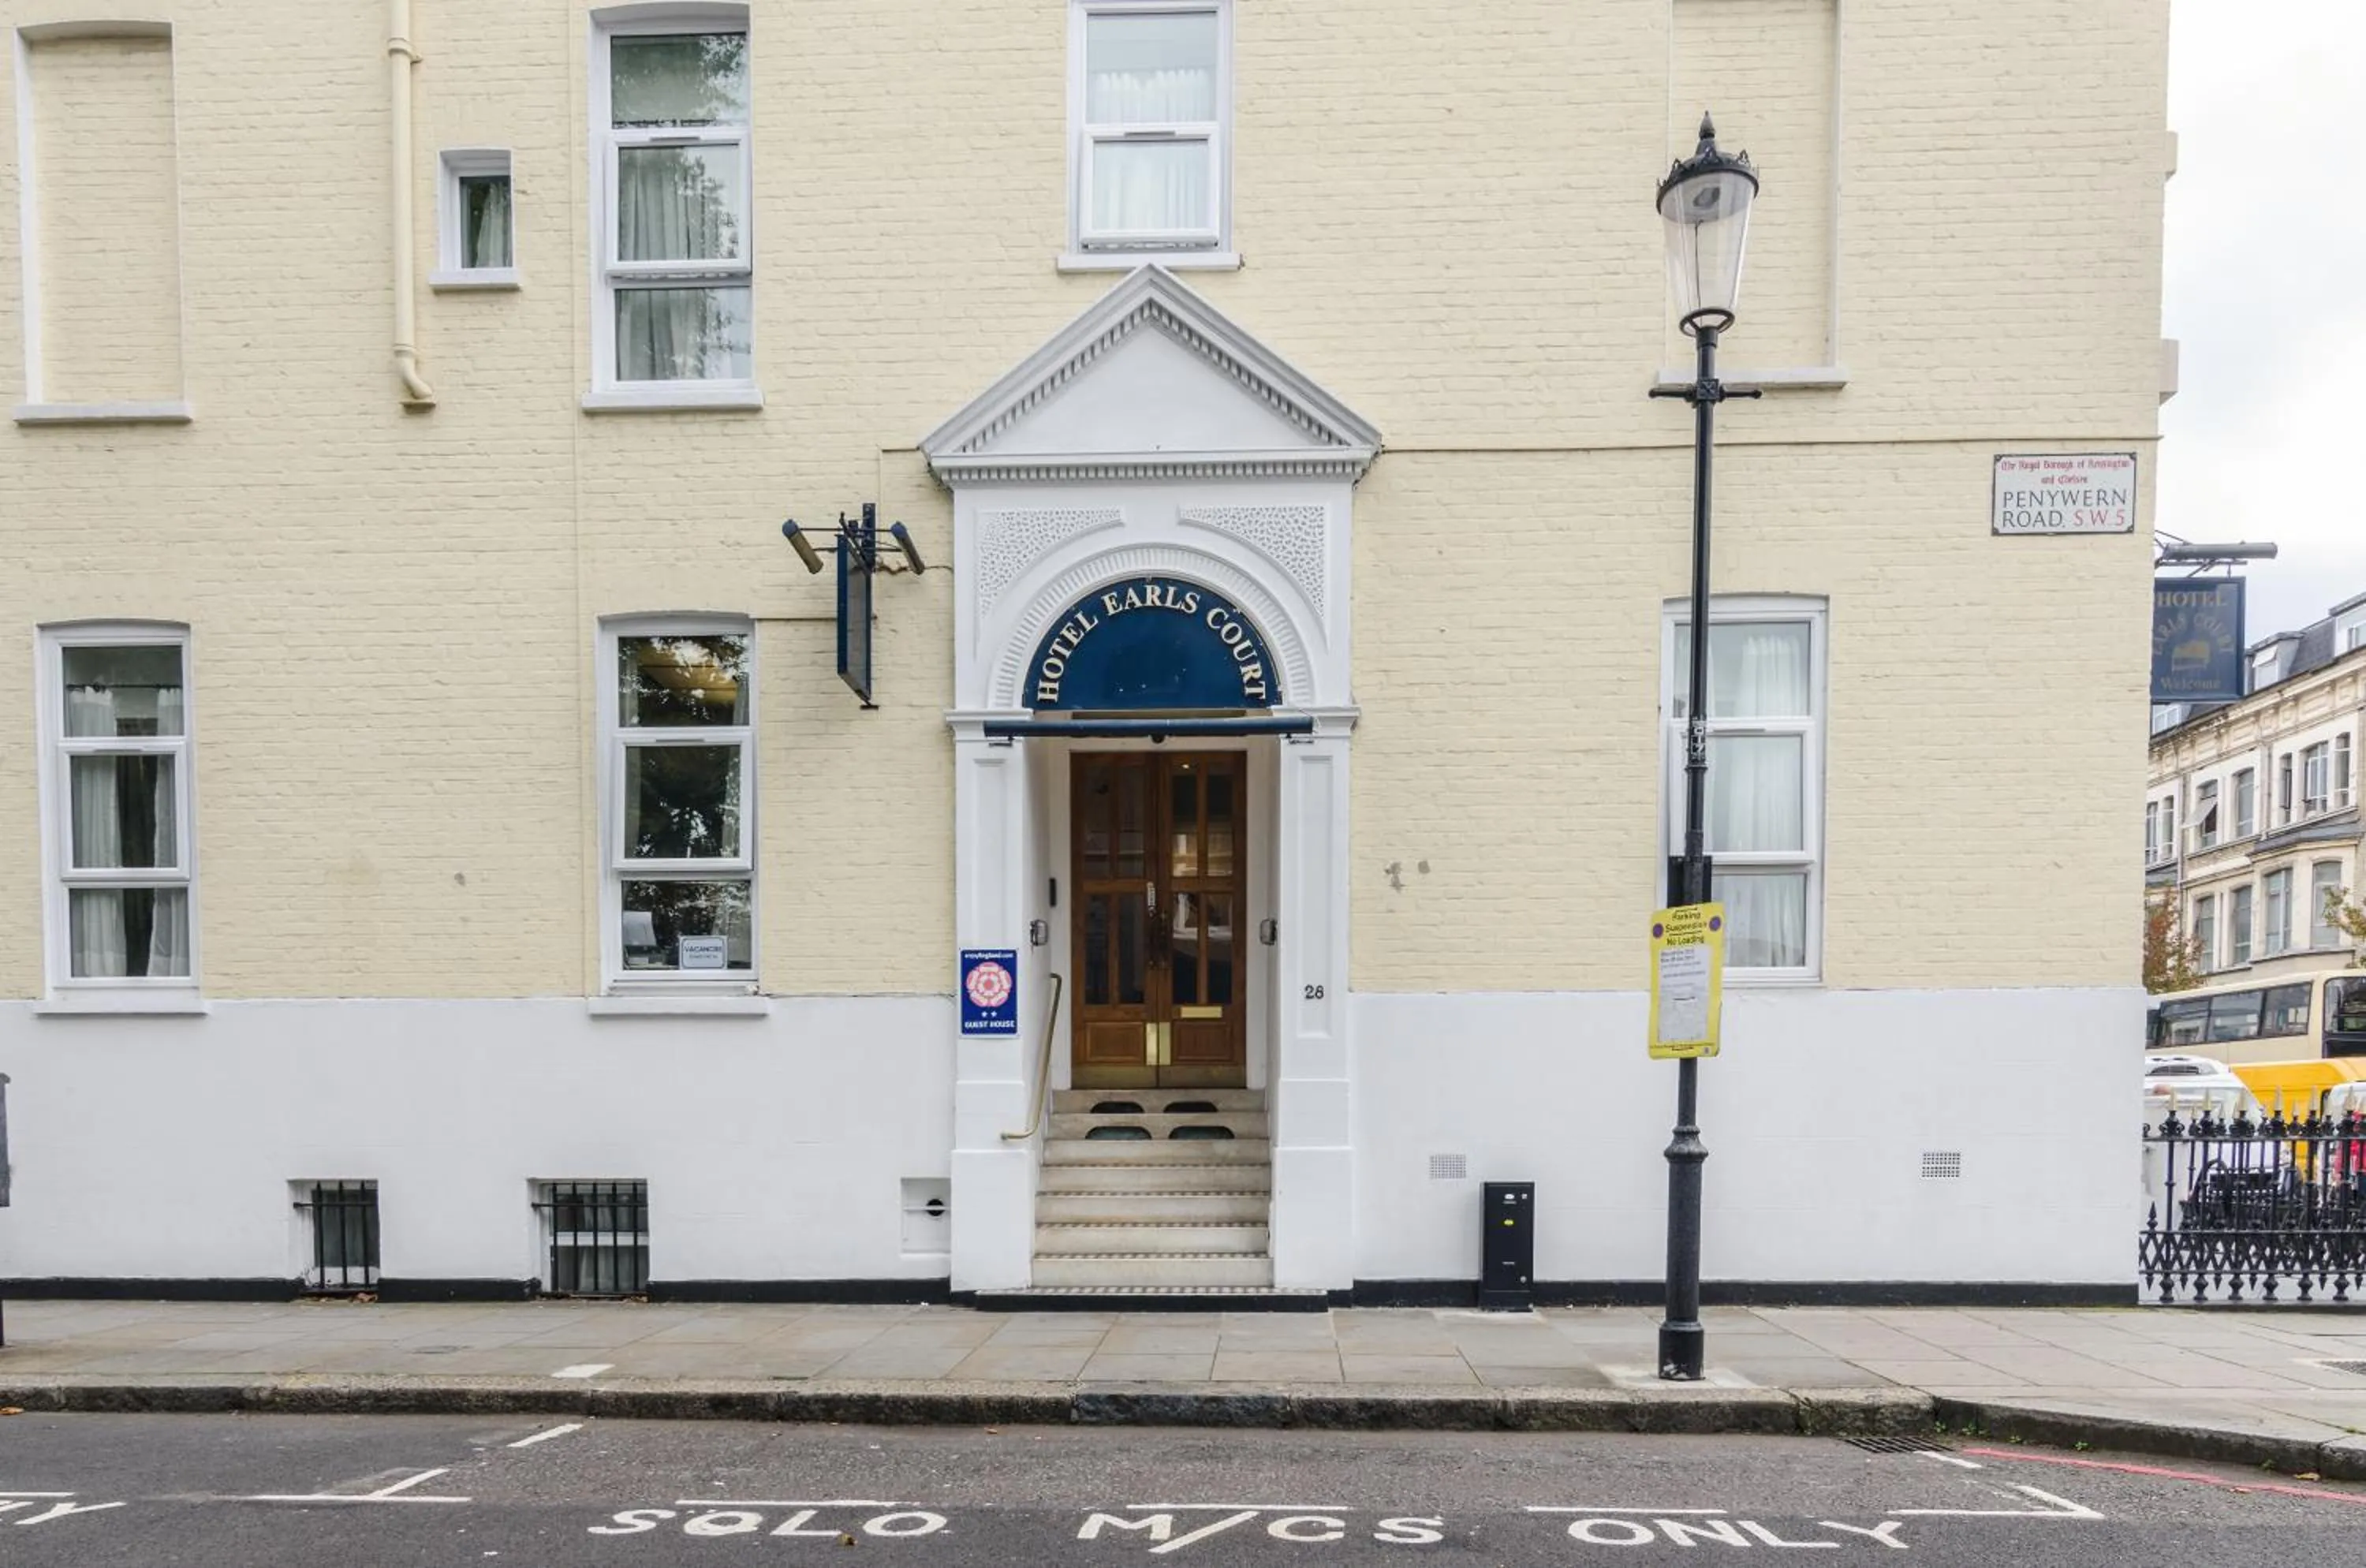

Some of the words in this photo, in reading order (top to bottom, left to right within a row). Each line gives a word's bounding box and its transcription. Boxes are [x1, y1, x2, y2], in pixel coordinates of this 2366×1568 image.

[2003, 488, 2127, 509] PENYWERN
[2157, 592, 2227, 607] HOTEL
[1036, 610, 1099, 704] HOTEL
[1101, 584, 1201, 616] EARLS
[1206, 608, 1266, 700] COURT
[2160, 678, 2221, 690] Welcome
[1672, 913, 1701, 921] Parking
[1304, 984, 1324, 999] 28
[588, 1510, 946, 1536] SOLO
[1567, 1518, 1909, 1548] ONLY
